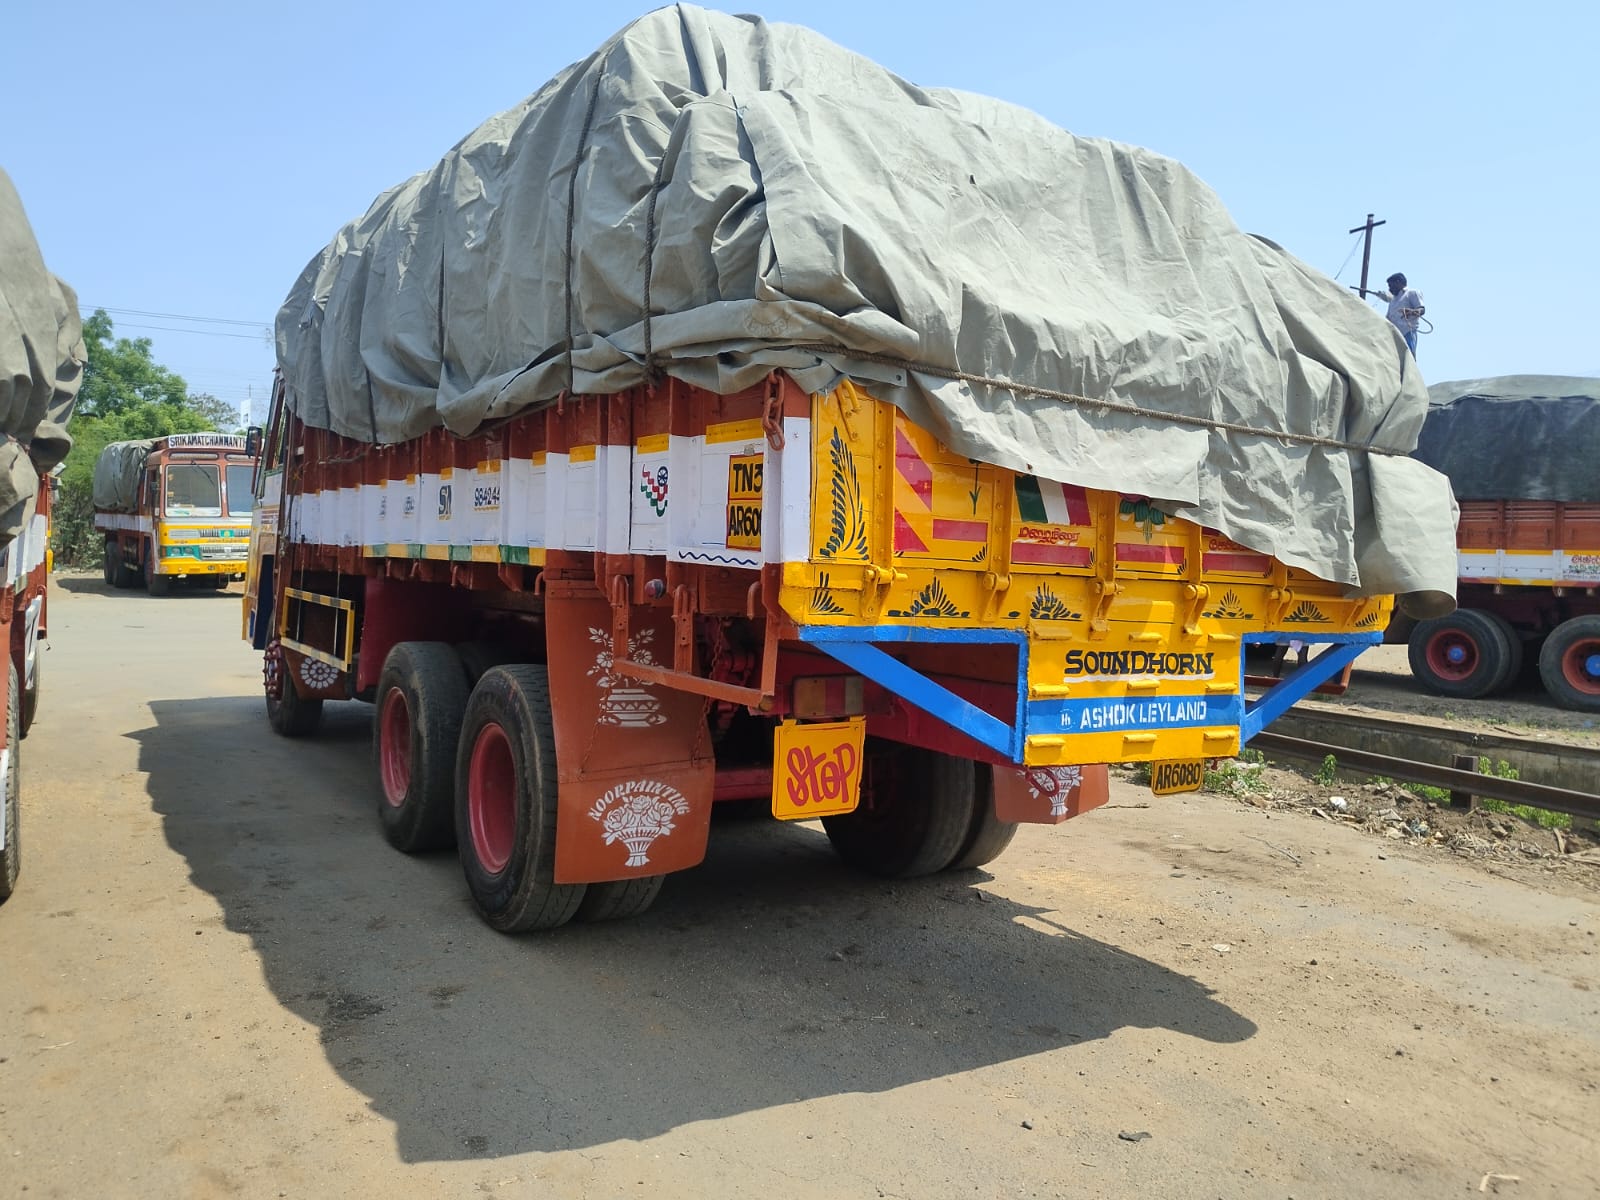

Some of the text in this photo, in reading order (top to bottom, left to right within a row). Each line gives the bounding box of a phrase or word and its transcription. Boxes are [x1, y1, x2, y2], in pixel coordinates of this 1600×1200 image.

[733, 463, 763, 493] TN3
[728, 506, 762, 537] AR60
[1080, 701, 1207, 730] ASHOK LEYLAND
[1154, 763, 1202, 791] AR6080
